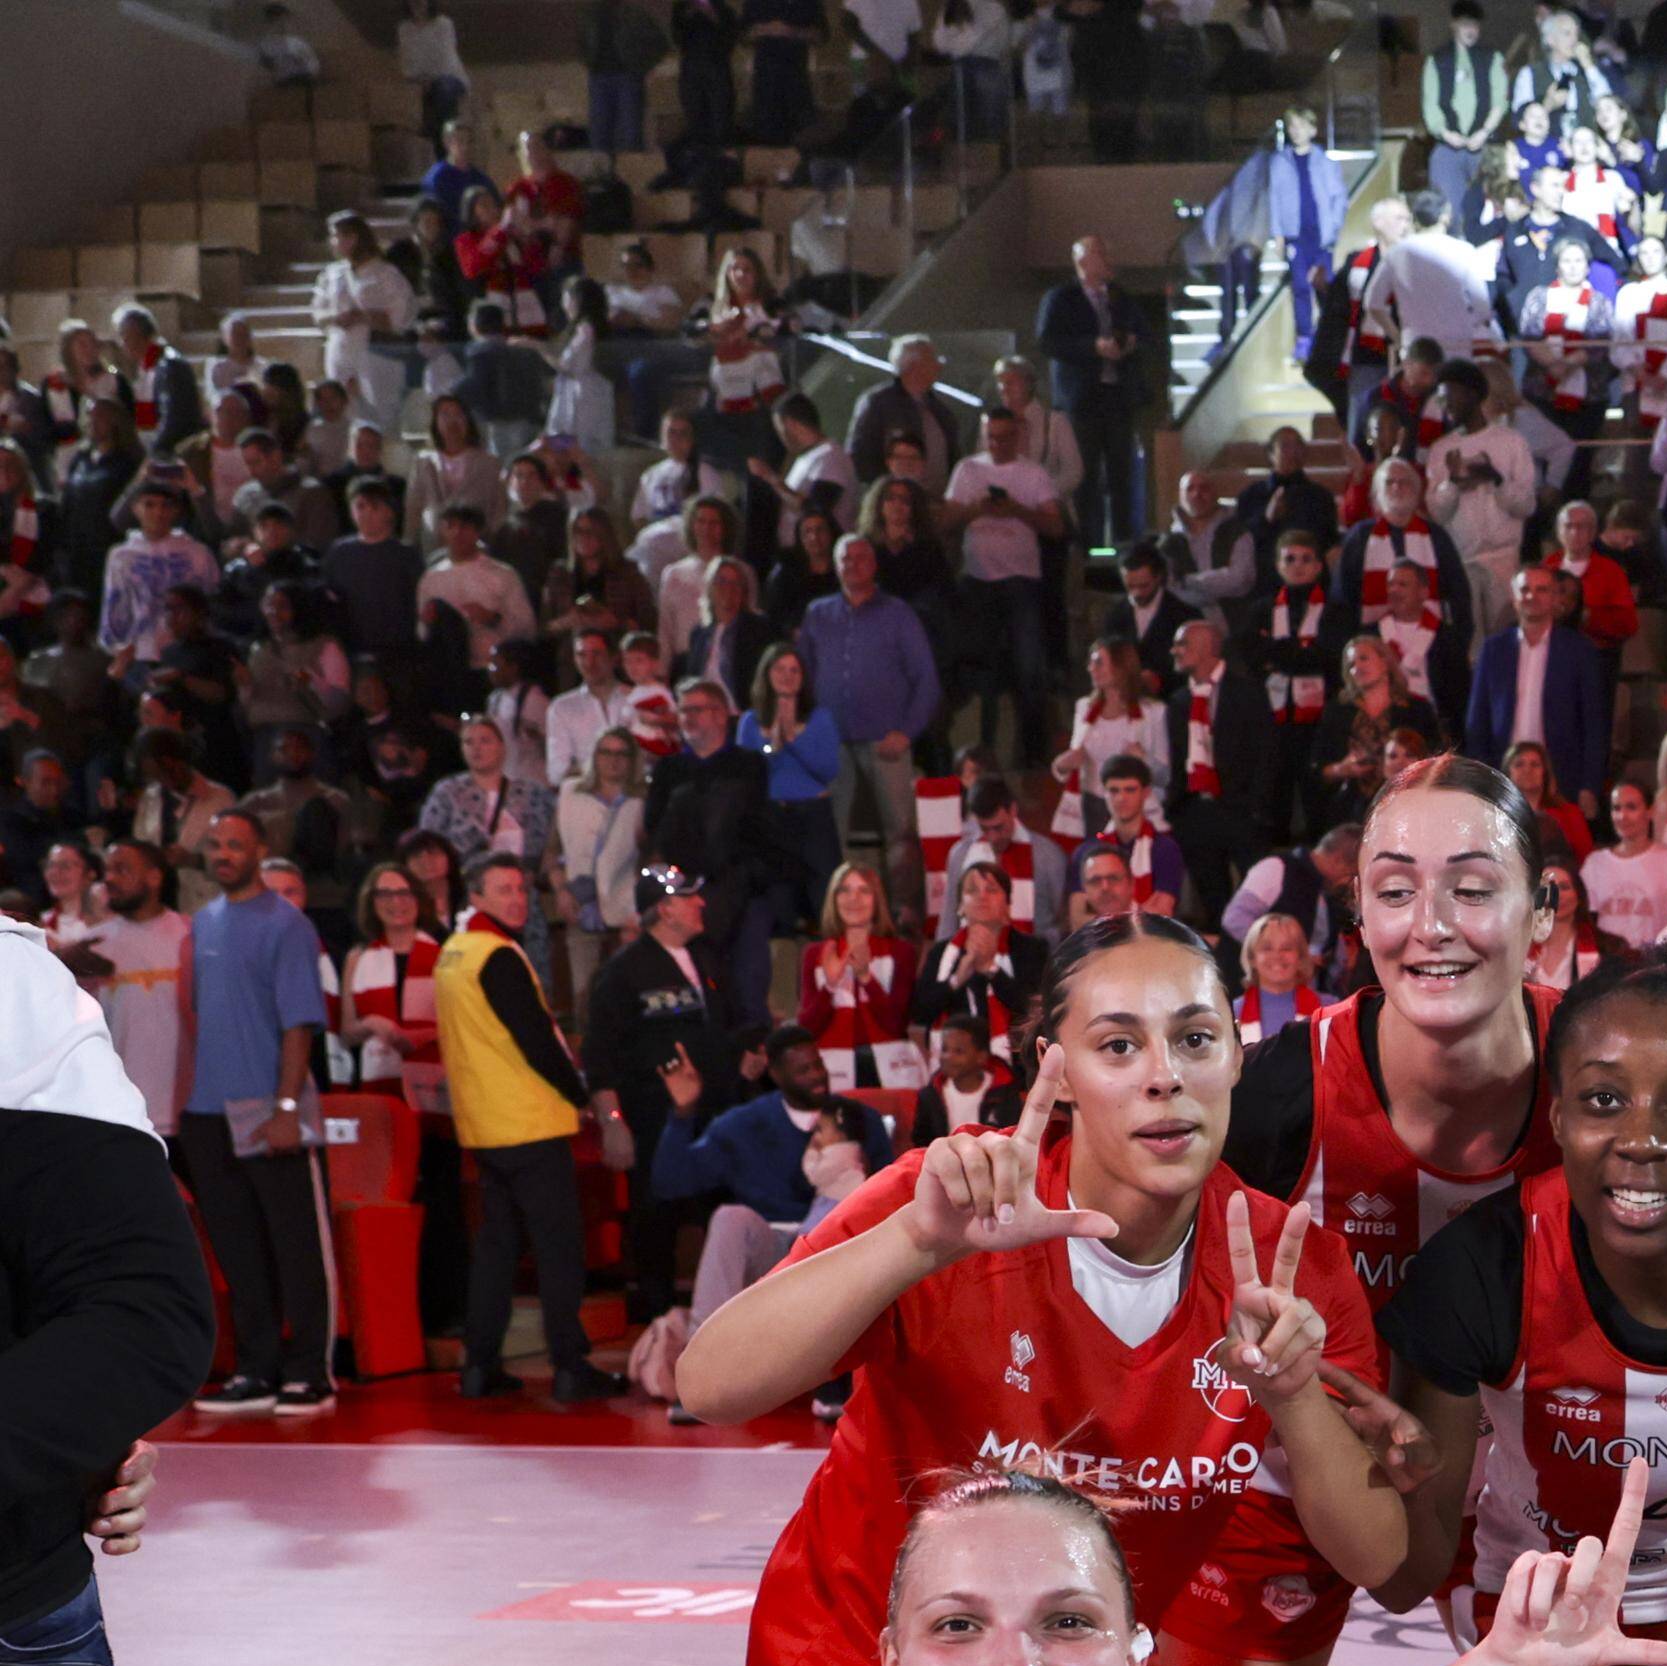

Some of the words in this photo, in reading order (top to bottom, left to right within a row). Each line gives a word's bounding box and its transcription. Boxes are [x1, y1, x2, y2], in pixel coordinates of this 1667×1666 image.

[1344, 1219, 1397, 1236] errea
[1546, 1402, 1601, 1423] errea
[1137, 1442, 1259, 1490] CARO
[1190, 1582, 1230, 1607] errea
